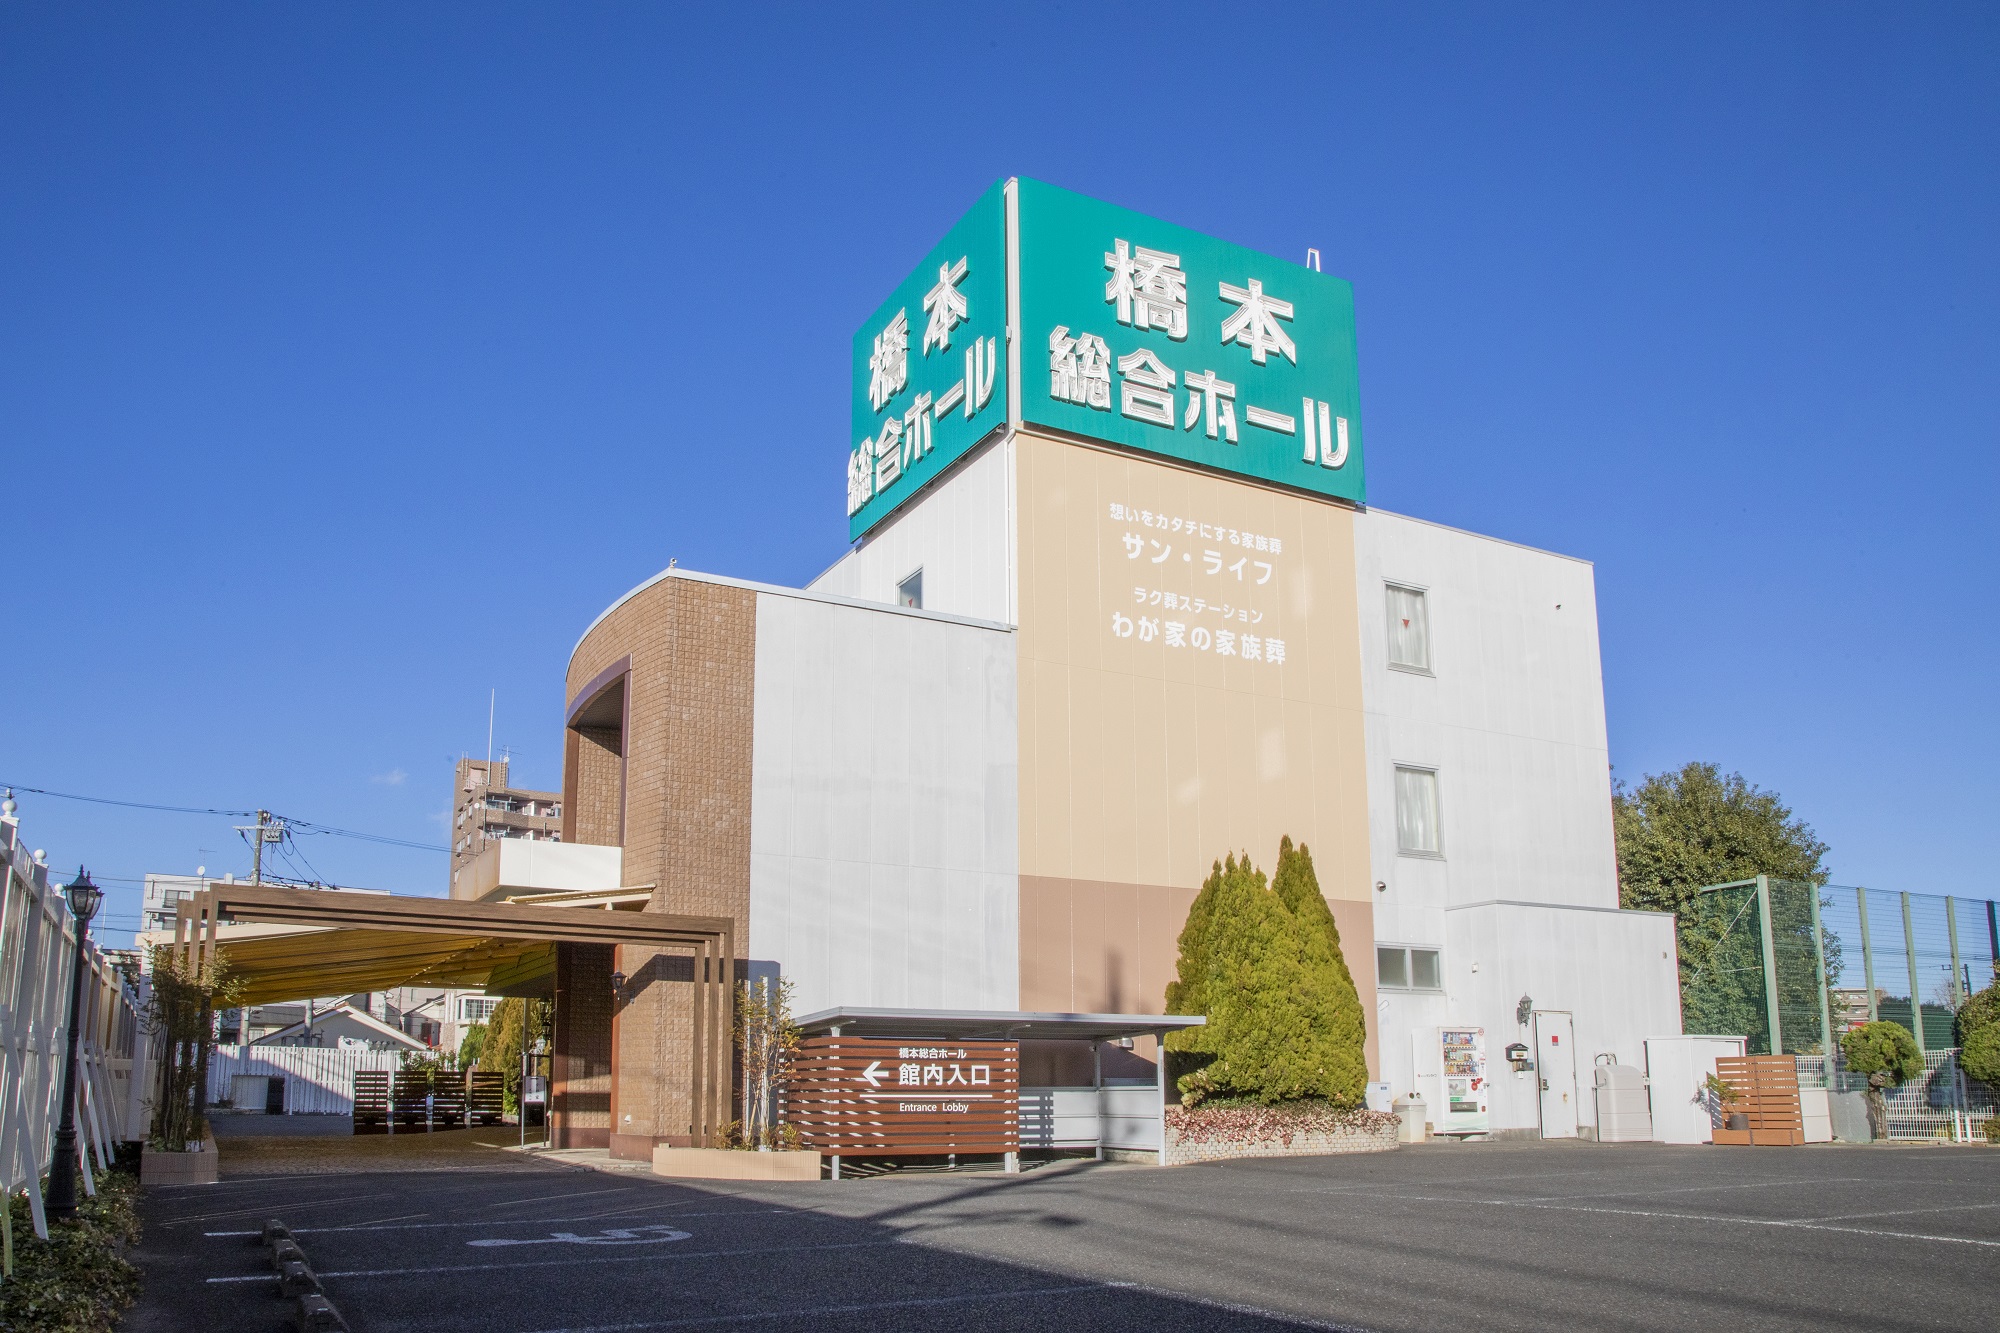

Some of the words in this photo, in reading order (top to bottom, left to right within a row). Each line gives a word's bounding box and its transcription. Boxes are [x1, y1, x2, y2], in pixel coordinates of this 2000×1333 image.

[1104, 238, 1296, 365] 橋本
[870, 255, 966, 412] 橋本
[1049, 325, 1349, 469] 総合ホール
[847, 336, 996, 516] 総合ホール
[1109, 502, 1282, 555] 想いをカタチにする家族葬
[1122, 532, 1272, 585] サン・ライフ
[1134, 586, 1263, 624] ラク葬ステーション
[1112, 611, 1286, 665] わが家の家族葬
[898, 1047, 967, 1060] 橋本総合ホール
[898, 1063, 990, 1086] 館内入口
[899, 1102, 937, 1112] Entrance
[942, 1102, 969, 1113] Lobby
